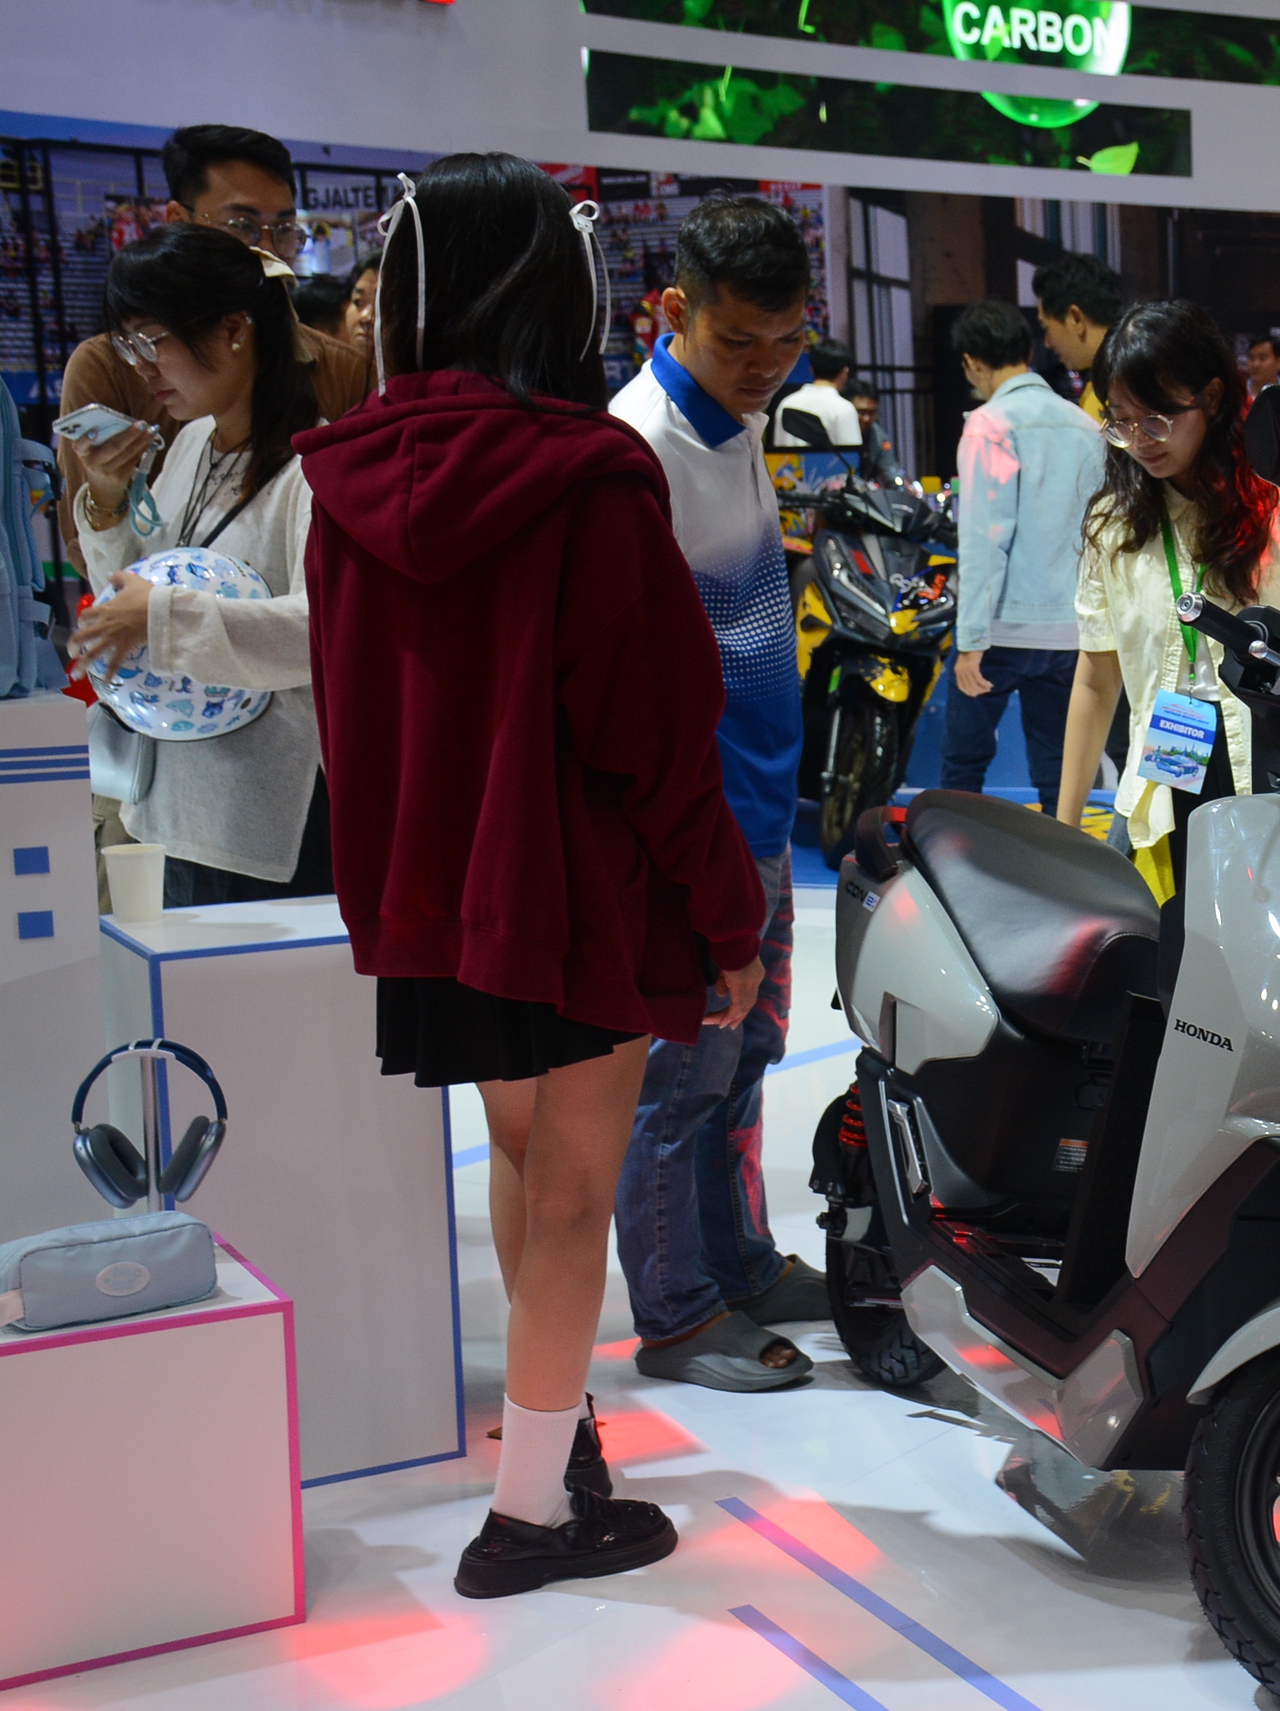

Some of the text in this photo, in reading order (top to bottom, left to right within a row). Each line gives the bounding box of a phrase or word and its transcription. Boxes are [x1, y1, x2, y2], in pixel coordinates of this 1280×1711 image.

[952, 1, 1118, 57] CARBON
[1160, 719, 1205, 739] EXHIBITOR
[1174, 1018, 1234, 1052] HONDA
